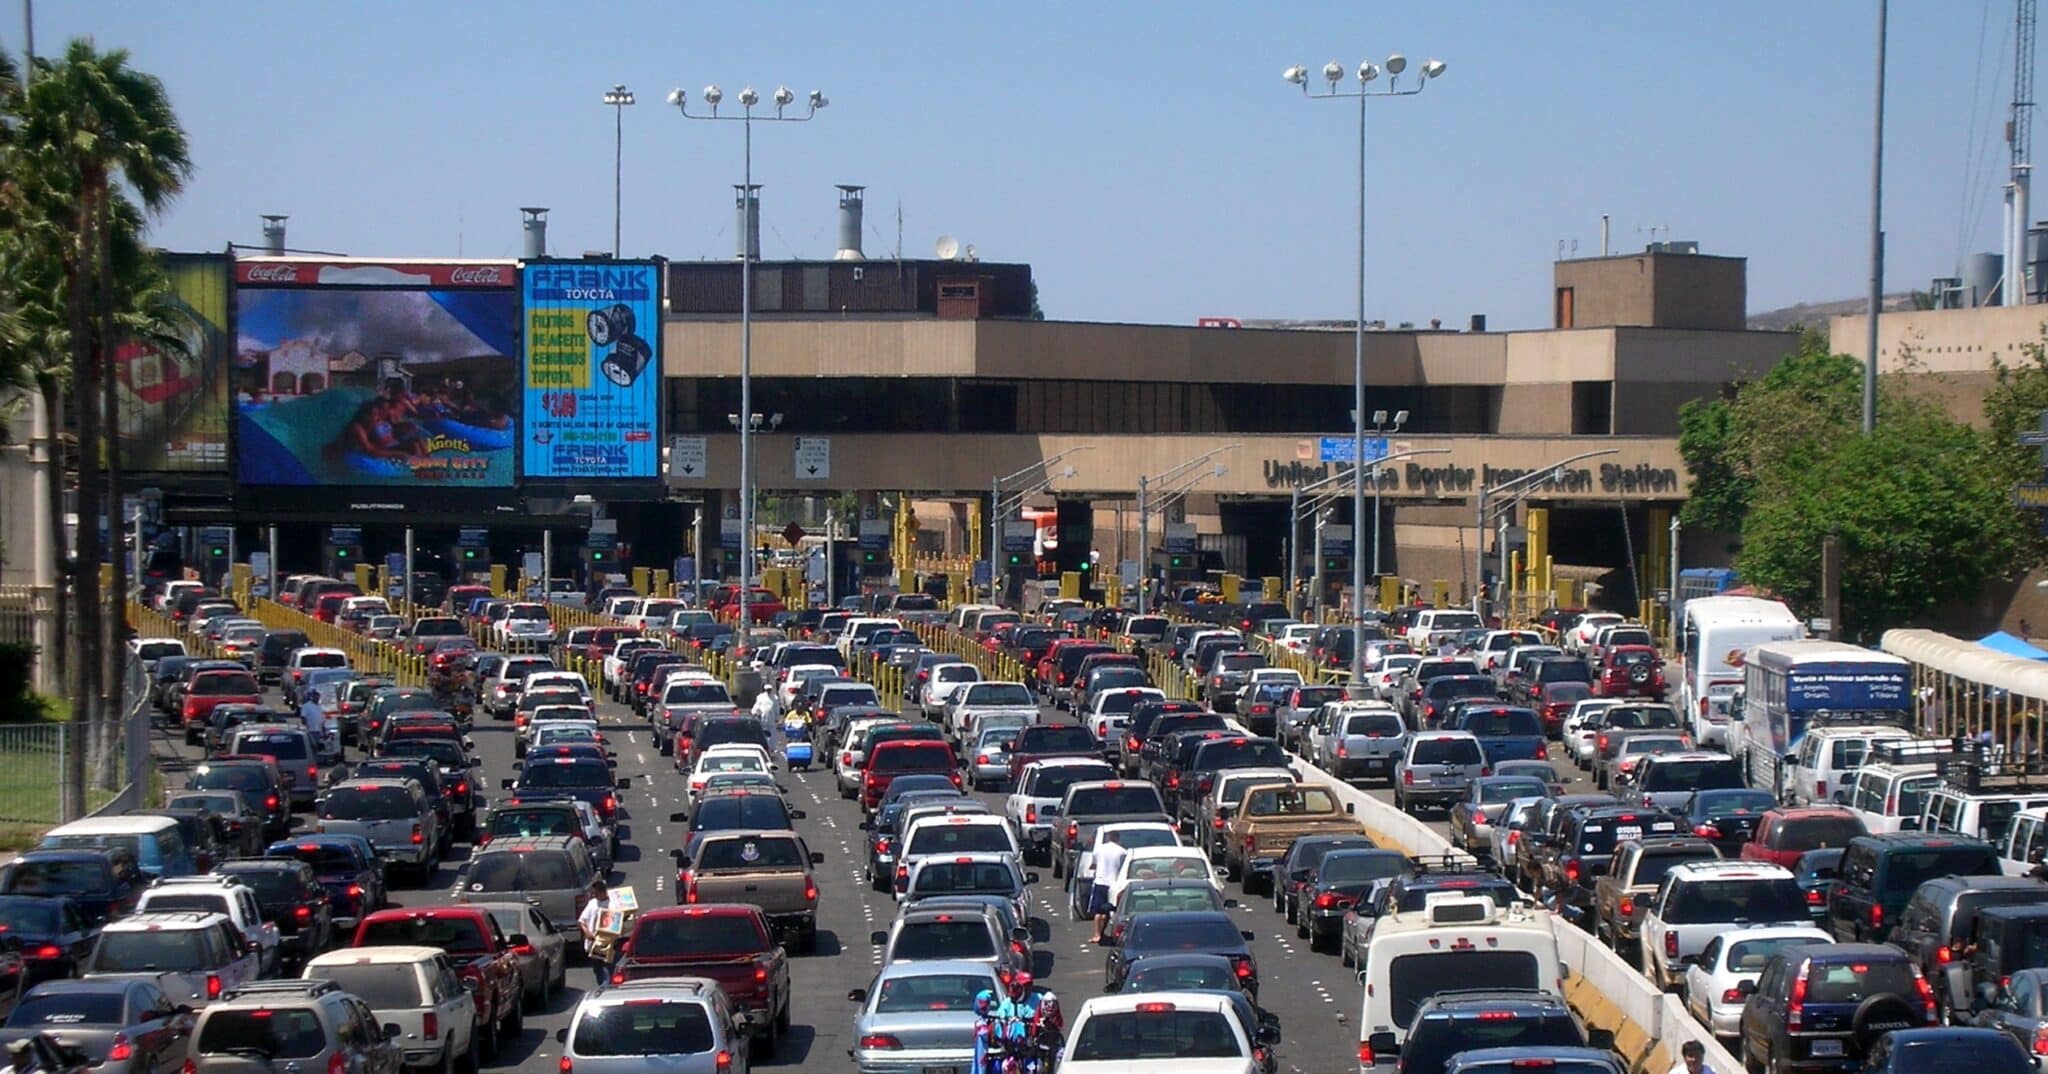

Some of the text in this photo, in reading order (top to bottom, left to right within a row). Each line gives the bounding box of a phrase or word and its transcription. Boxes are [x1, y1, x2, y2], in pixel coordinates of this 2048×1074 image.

[248, 264, 296, 281] Coca-Cola
[451, 266, 502, 283] Coca-Cola
[566, 289, 615, 300] TOYOTA
[531, 371, 573, 384] TOYOTA
[426, 434, 470, 453] Knott's
[1264, 460, 1328, 488] United
[1406, 462, 1475, 492] Border
[1600, 462, 1677, 494] Station
[1868, 1021, 1912, 1031] HONDA
